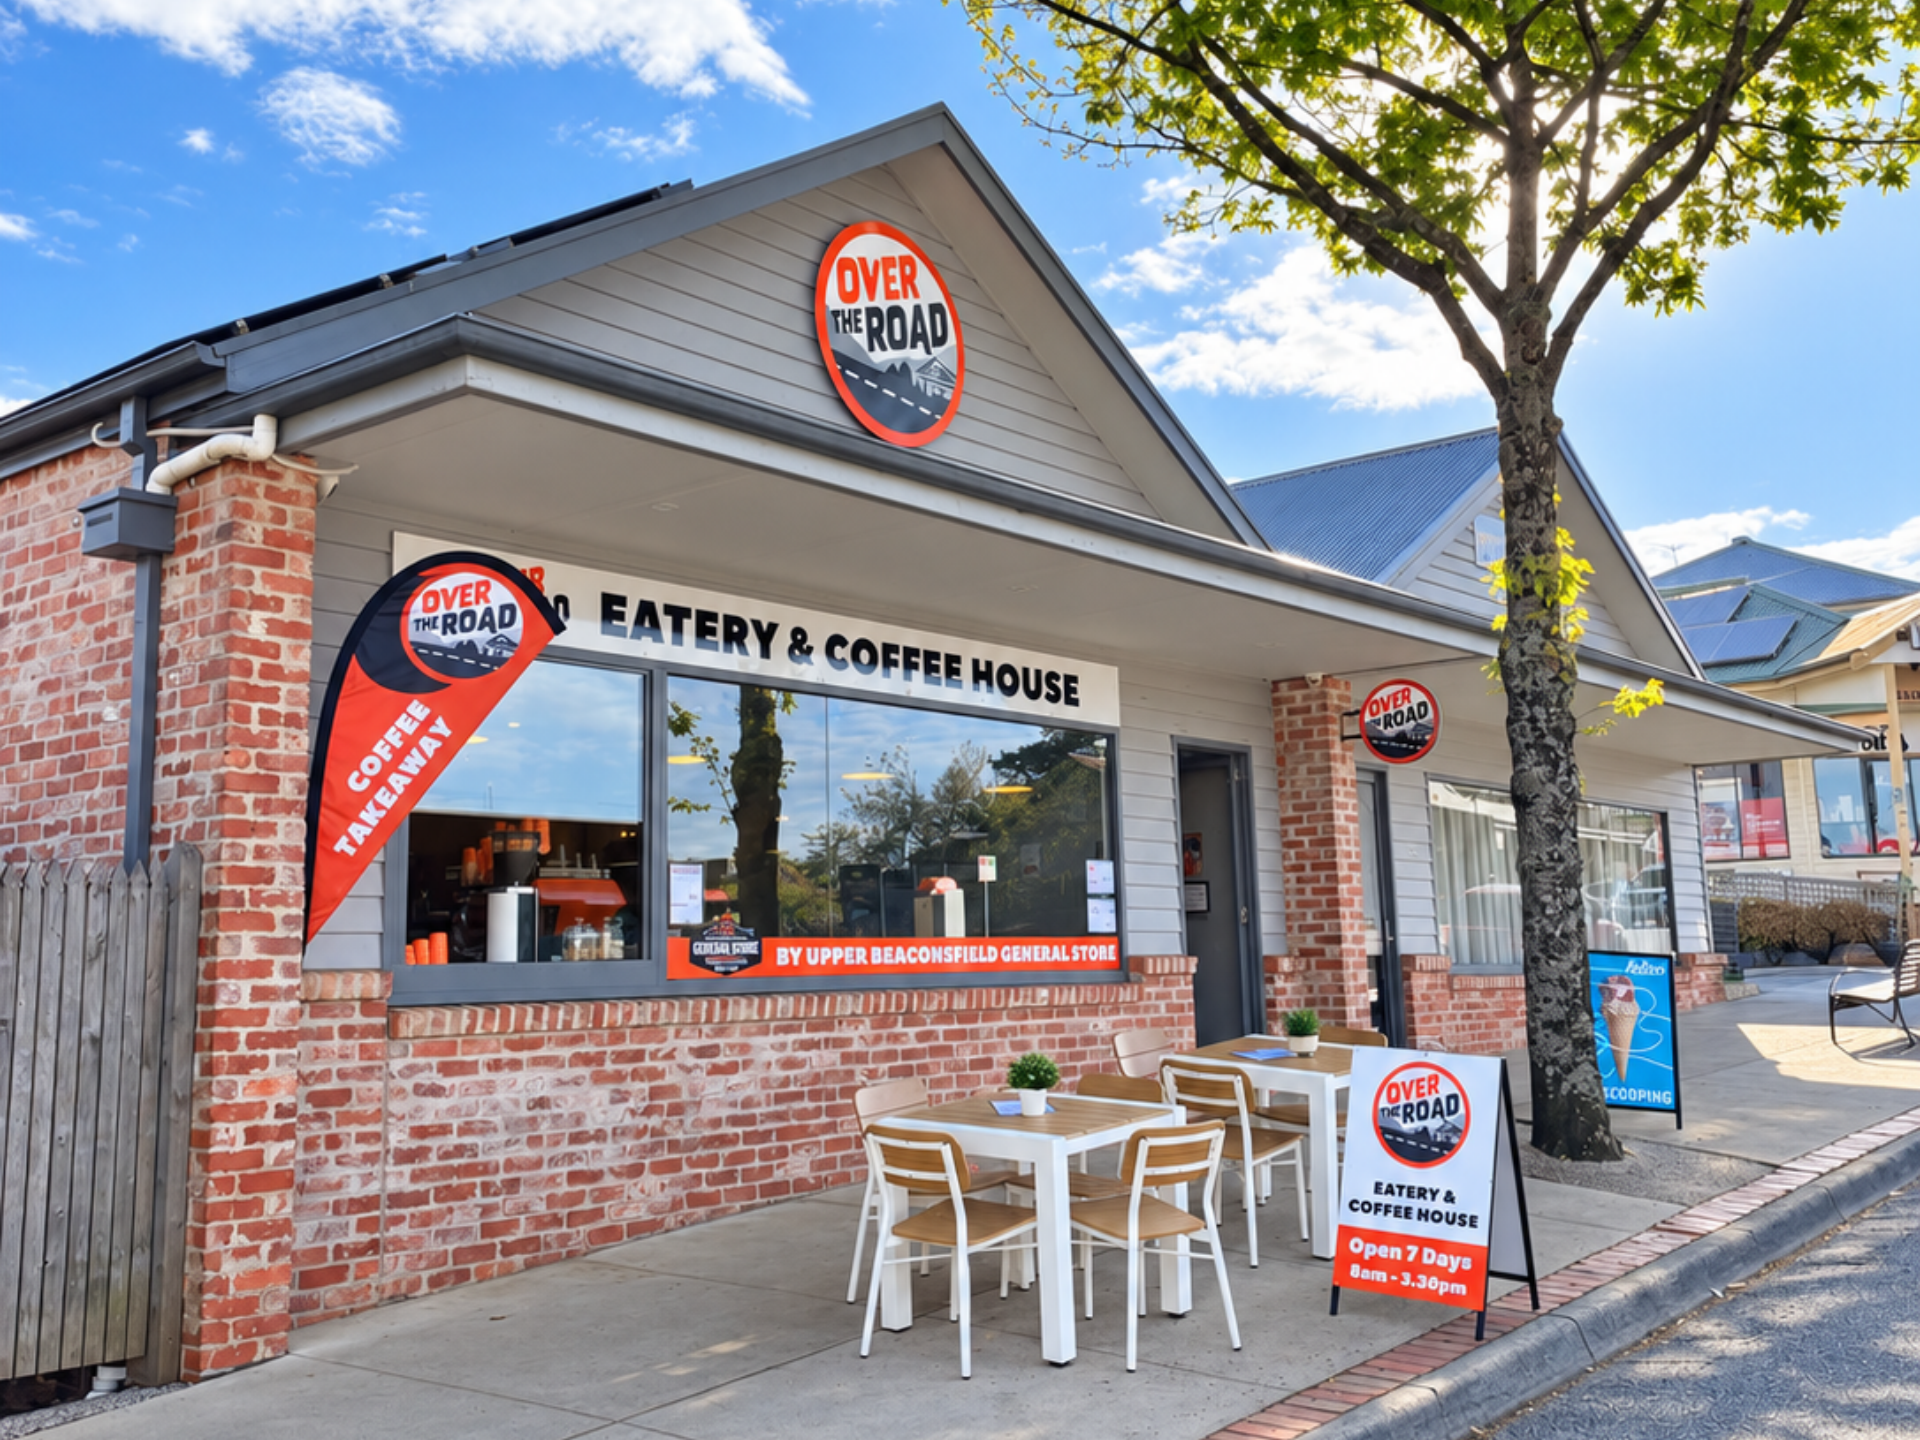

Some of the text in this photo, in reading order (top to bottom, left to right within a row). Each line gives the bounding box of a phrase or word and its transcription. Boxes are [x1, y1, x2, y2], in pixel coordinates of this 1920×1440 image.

[835, 254, 920, 304] OVER
[831, 302, 949, 355] THE ROAD
[422, 579, 492, 614] OVER
[413, 603, 517, 636] THE ROAD
[600, 592, 779, 660] EATERY
[788, 626, 814, 666] &
[825, 633, 963, 690] COFFEE
[972, 658, 1080, 707] HOUSE
[1368, 687, 1412, 717] OVER
[1383, 700, 1428, 730] ROAD
[347, 699, 431, 792] COFFEE
[333, 715, 452, 857] TAKEAWAY
[776, 947, 803, 966] BY
[806, 946, 868, 966] UPPER
[871, 945, 998, 965] BEACONSFIELD
[1000, 945, 1070, 963] GENERAL
[1072, 944, 1116, 962] STORE
[1386, 1073, 1440, 1105] OVER
[1403, 1093, 1460, 1124] ROAD
[1374, 1181, 1456, 1204] EATERY &
[1348, 1199, 1479, 1228] COFFEE HOUSE
[1349, 1237, 1472, 1273] Open 7 Days
[1350, 1263, 1387, 1283] 8am
[1400, 1272, 1467, 1296] 3.30pm
